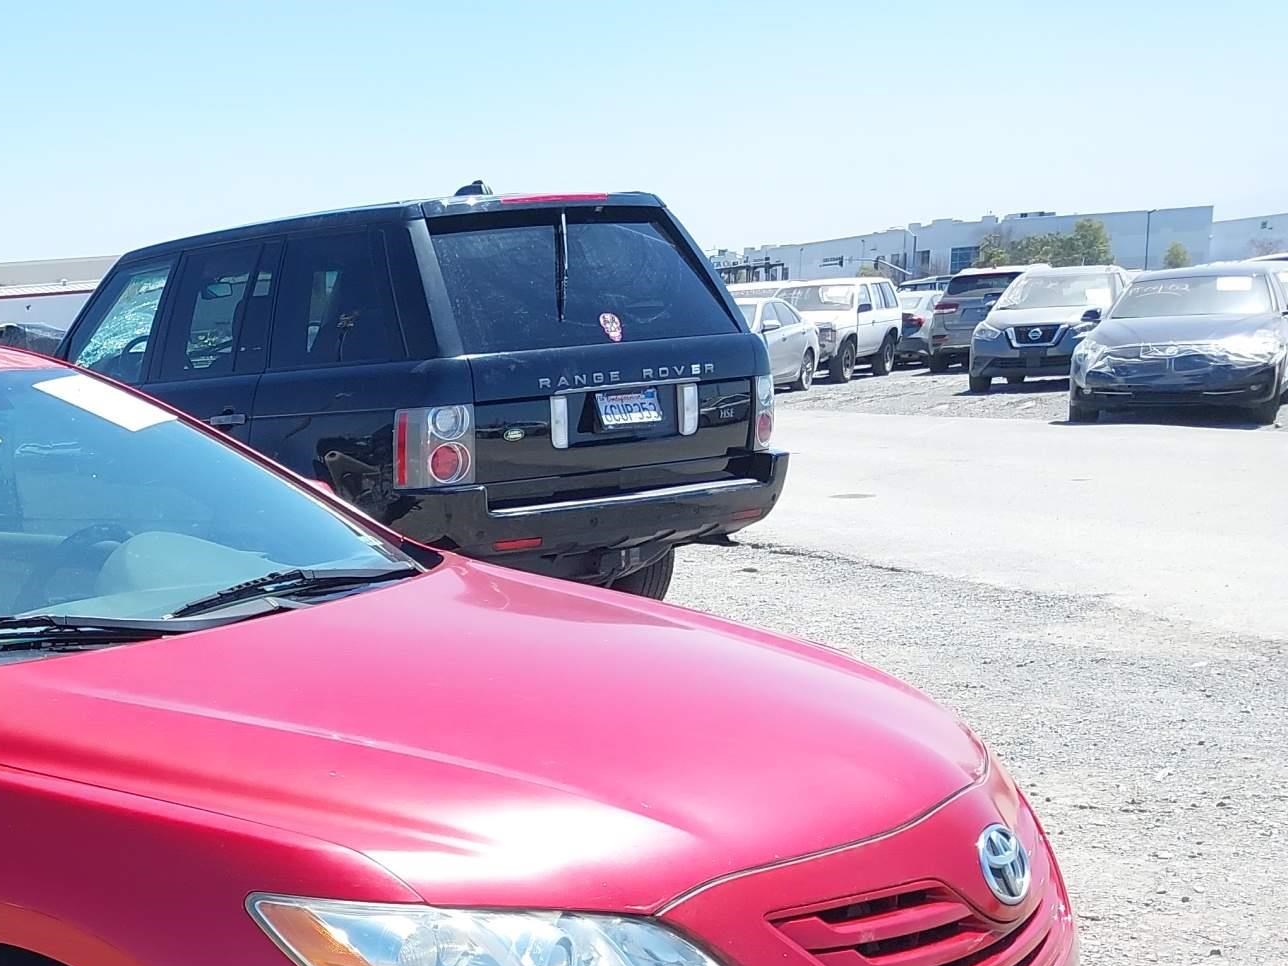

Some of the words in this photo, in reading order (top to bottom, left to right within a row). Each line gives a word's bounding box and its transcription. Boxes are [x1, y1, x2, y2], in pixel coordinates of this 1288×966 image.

[538, 371, 621, 389] RANGE
[642, 363, 715, 379] ROVER
[719, 408, 735, 419] HSE
